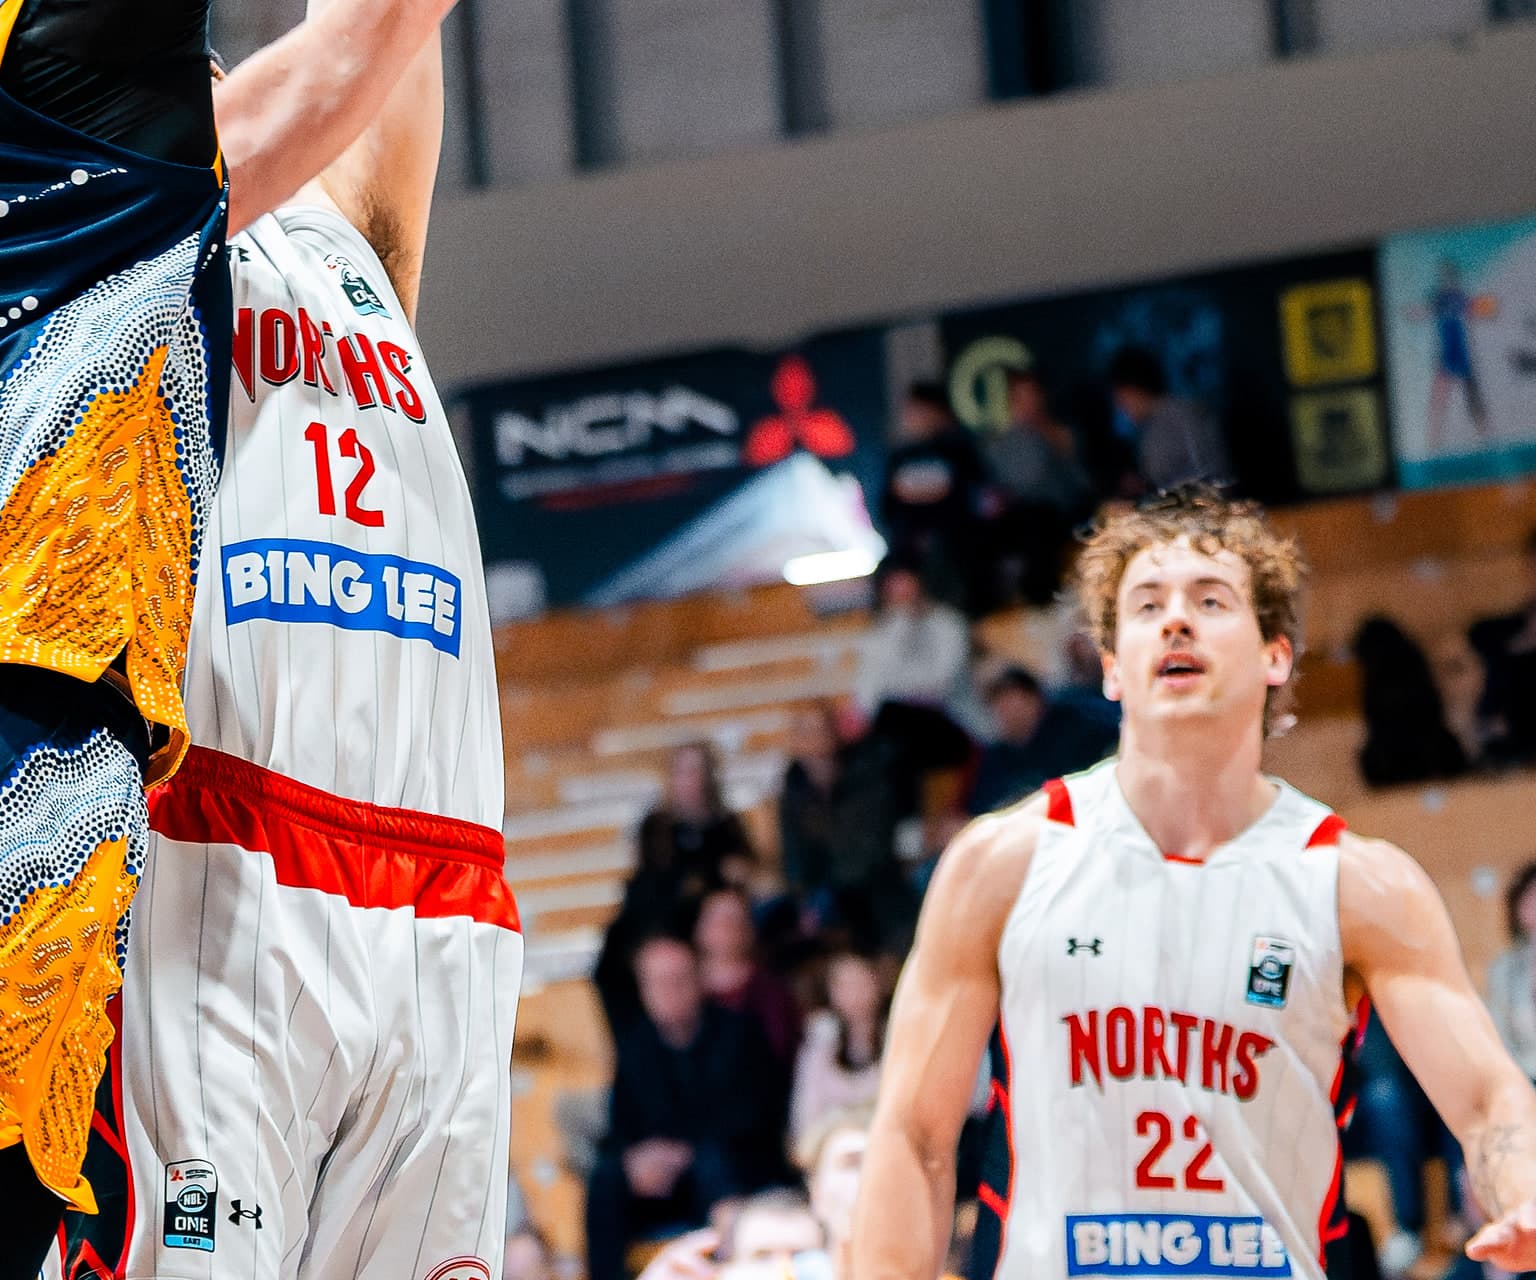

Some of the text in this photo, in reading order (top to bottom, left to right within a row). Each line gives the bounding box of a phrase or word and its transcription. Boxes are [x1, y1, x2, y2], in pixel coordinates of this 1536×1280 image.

[303, 421, 386, 528] 12
[224, 550, 459, 637] BING LEE
[1061, 1005, 1278, 1103] NORTHS
[1134, 1110, 1226, 1194] 22
[173, 1215, 210, 1235] ONE
[1072, 1220, 1288, 1269] BING LEE
